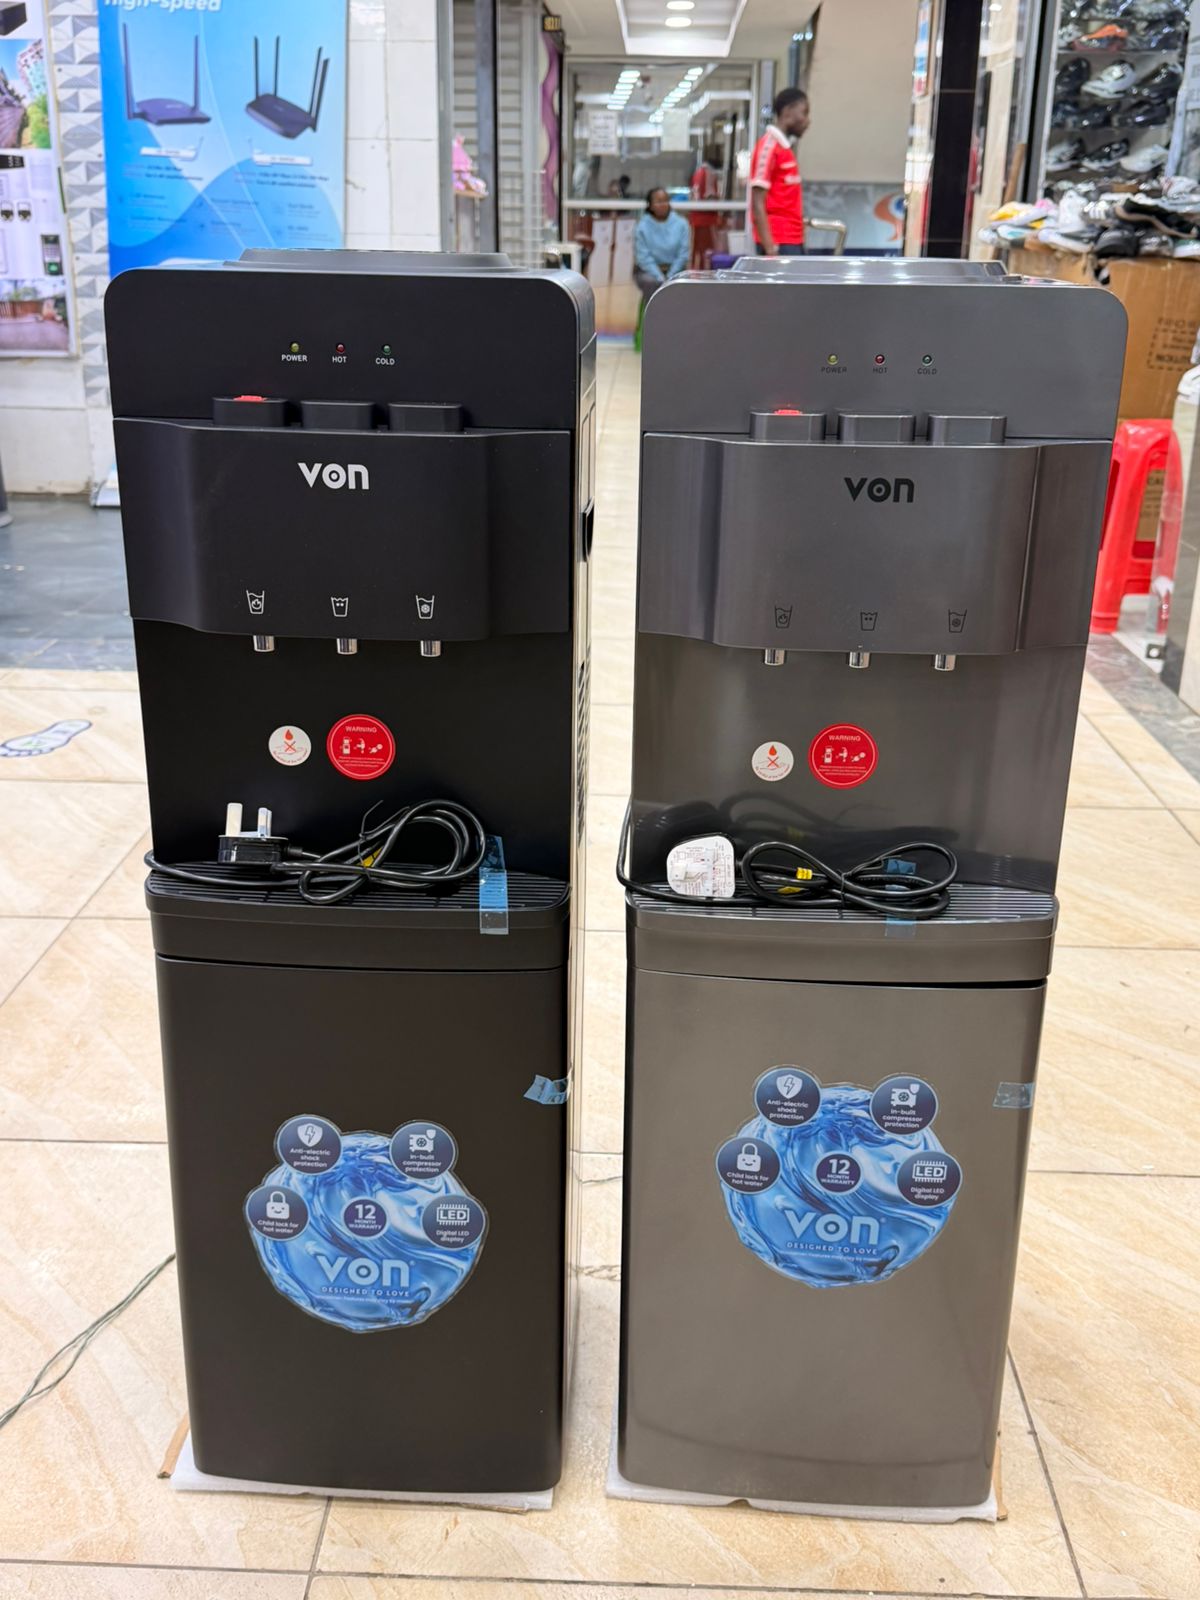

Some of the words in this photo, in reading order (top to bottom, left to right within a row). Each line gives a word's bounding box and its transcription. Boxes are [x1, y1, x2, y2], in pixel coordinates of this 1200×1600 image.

[281, 354, 308, 362] POWER
[375, 357, 396, 365] COLD
[821, 366, 848, 374] POWER
[345, 725, 378, 733] WARNING
[828, 734, 862, 742] WARNING
[766, 1099, 809, 1108] Anti-electric
[769, 1112, 805, 1120] protection
[882, 1114, 923, 1122] compressor
[884, 1121, 920, 1129] protection
[289, 1147, 331, 1156] Anti-electric
[293, 1160, 328, 1168] protection
[829, 1158, 850, 1175] 12
[726, 1171, 745, 1179] Child
[915, 1166, 944, 1177] LED
[910, 1186, 932, 1194] Digital
[914, 1192, 940, 1200] display
[355, 1204, 376, 1219] 12
[439, 1210, 467, 1221] LED
[257, 1219, 275, 1227] Child
[436, 1230, 457, 1238] Digital
[786, 1241, 834, 1251] DESIGNED
[321, 1286, 368, 1295] DESIGNED
